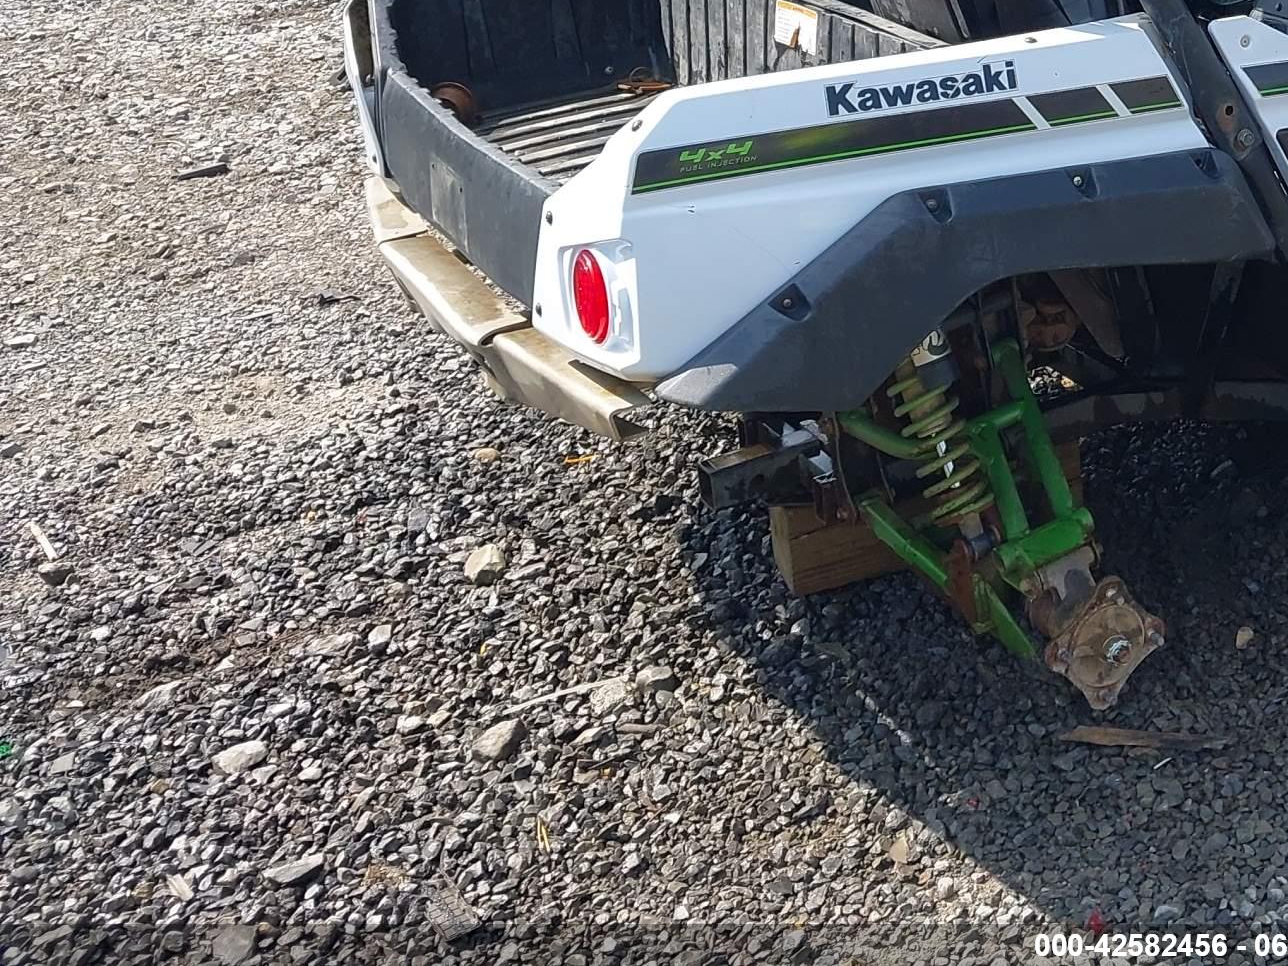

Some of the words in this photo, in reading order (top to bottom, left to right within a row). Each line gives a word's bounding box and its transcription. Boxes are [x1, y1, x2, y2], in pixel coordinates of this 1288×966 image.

[825, 61, 1018, 116] Kawasaki
[680, 140, 753, 163] 4x4
[680, 164, 703, 172] FUEL
[707, 155, 756, 168] INJECTION
